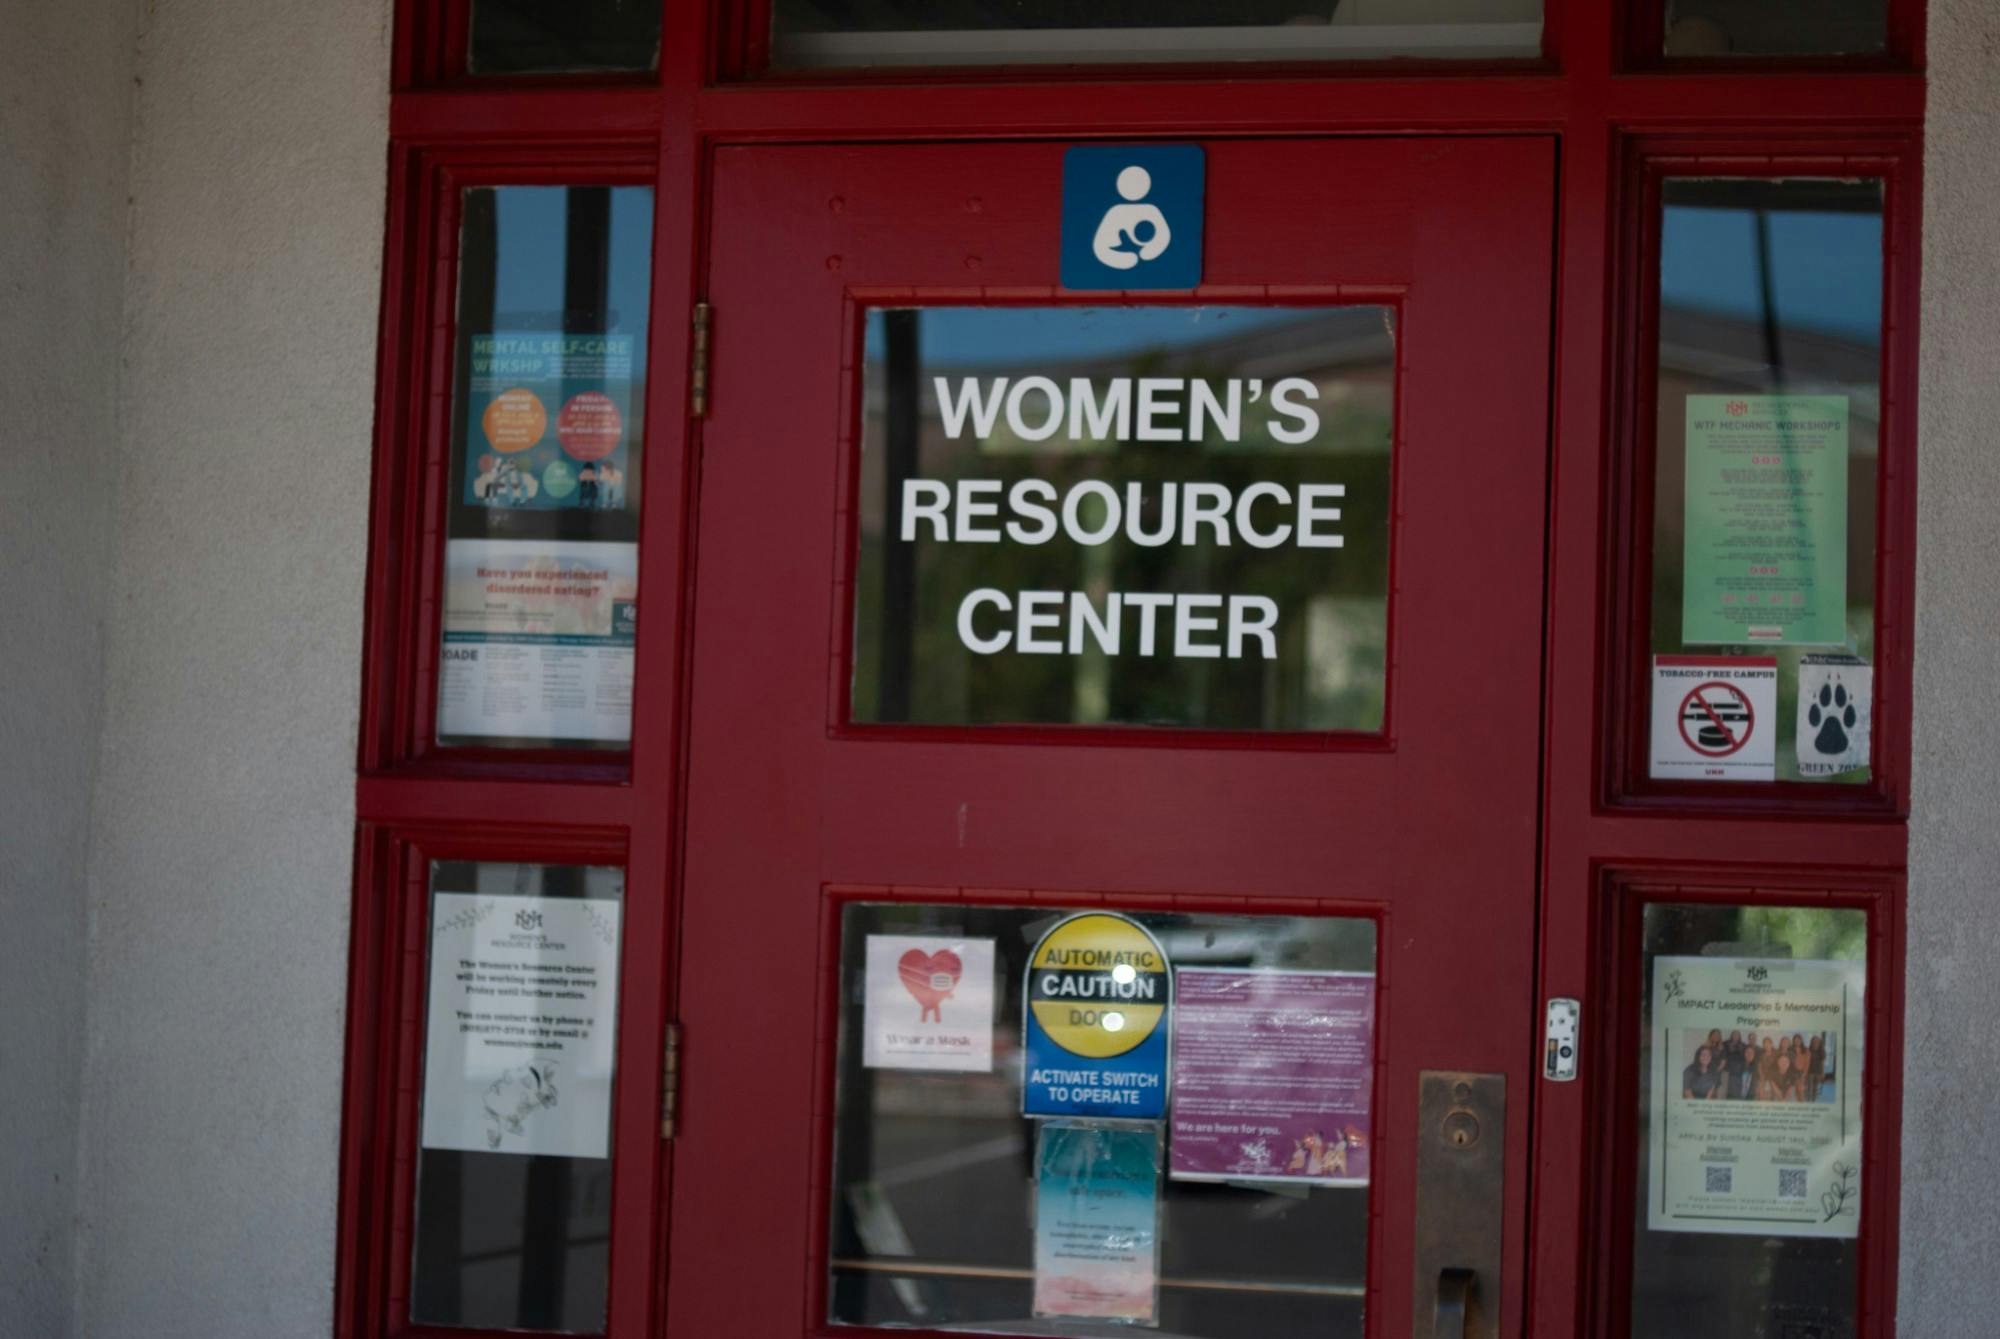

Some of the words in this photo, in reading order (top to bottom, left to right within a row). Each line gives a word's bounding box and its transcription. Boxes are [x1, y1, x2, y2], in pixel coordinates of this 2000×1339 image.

[473, 340, 537, 354] MENTAL
[541, 340, 628, 355] SELF-CARE
[473, 358, 543, 373] WRKSHP
[933, 375, 1321, 444] WOMEN'S
[1694, 420, 1716, 430] WTF
[1719, 420, 1771, 431] MECHANIC
[1775, 421, 1841, 431] WORKSHOPS
[900, 479, 1346, 549] RESOURCE
[476, 567, 506, 579] Have
[510, 569, 531, 581] you
[534, 568, 609, 581] experienced
[486, 583, 550, 594] disordered
[553, 585, 600, 597] eating?
[957, 588, 1279, 660] CENTER
[1659, 669, 1732, 679] TOBACCO-FREE
[1733, 670, 1776, 679] CAMPUS
[1044, 949, 1154, 967] AUTOMATIC
[459, 959, 476, 969] The
[478, 961, 519, 971] Women's
[564, 965, 596, 975] Center
[455, 972, 474, 981] will
[476, 973, 487, 981] be
[488, 974, 525, 985] working
[527, 976, 569, 987] remotely
[570, 979, 597, 989] every
[1041, 975, 1155, 1000] CAUTION
[465, 984, 496, 996] Friday
[497, 986, 519, 996] until
[520, 988, 553, 999] further
[554, 991, 587, 1000] notice.
[1677, 1000, 1715, 1010] IMPACT
[1718, 1001, 1771, 1012] Leadership
[1774, 1002, 1782, 1011] &
[1784, 1002, 1840, 1014] Mentorship
[455, 1009, 473, 1020] You
[475, 1012, 492, 1020] can
[493, 1012, 528, 1022] contact
[541, 1015, 553, 1025] by
[554, 1015, 584, 1026] phone
[1736, 1017, 1780, 1028] Program
[539, 1027, 551, 1038] by
[552, 1029, 579, 1039] email
[886, 1033, 924, 1047] Wear
[925, 1036, 935, 1046] a
[938, 1034, 972, 1048] Mask
[1031, 1069, 1099, 1085] ACTIVATE
[1101, 1071, 1159, 1087] SWITCH
[1048, 1087, 1069, 1102] TO
[1071, 1088, 1140, 1105] OPERATE
[1176, 1122, 1194, 1132] We
[1195, 1124, 1213, 1133] are
[1214, 1123, 1239, 1134] here
[1241, 1124, 1257, 1134] for
[1258, 1126, 1281, 1136] you.
